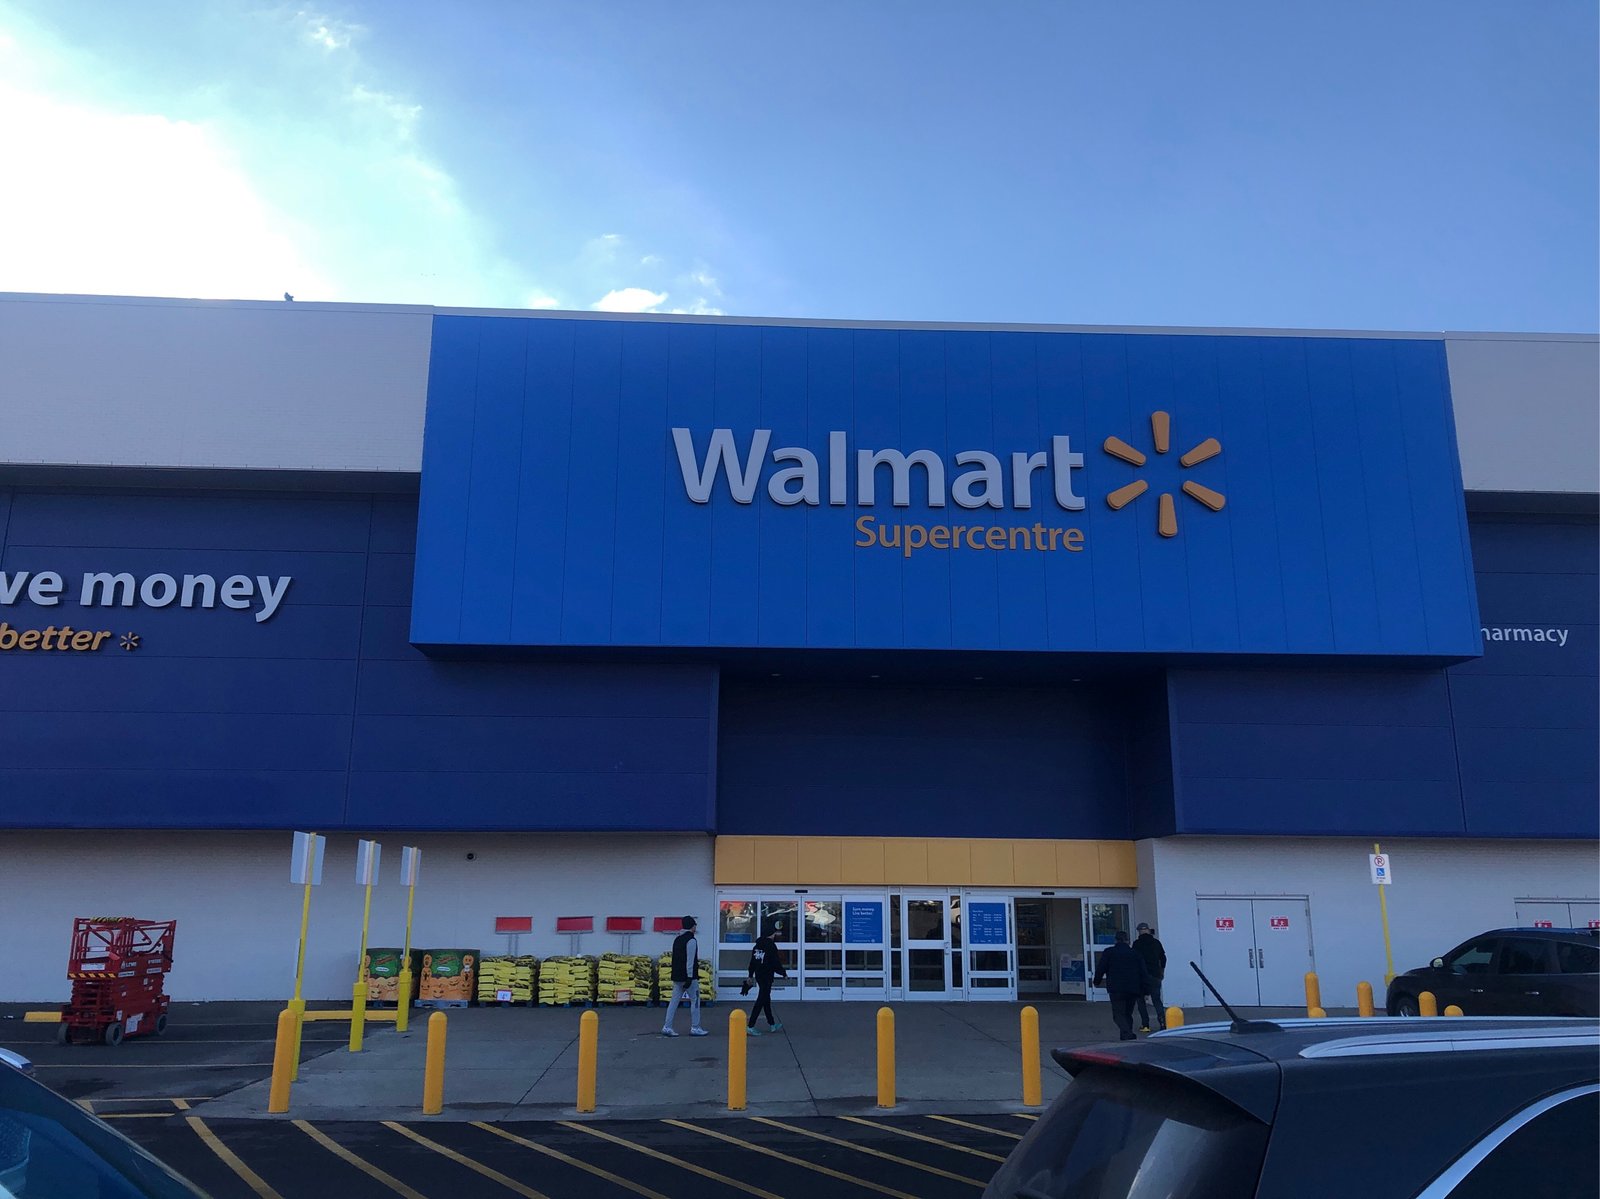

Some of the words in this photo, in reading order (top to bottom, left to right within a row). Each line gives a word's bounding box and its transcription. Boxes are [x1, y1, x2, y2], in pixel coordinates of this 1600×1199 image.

[671, 427, 1086, 512] Walmart
[855, 515, 1085, 558] Supercentre
[0, 569, 63, 607] ve
[79, 572, 292, 623] money
[0, 622, 111, 651] better
